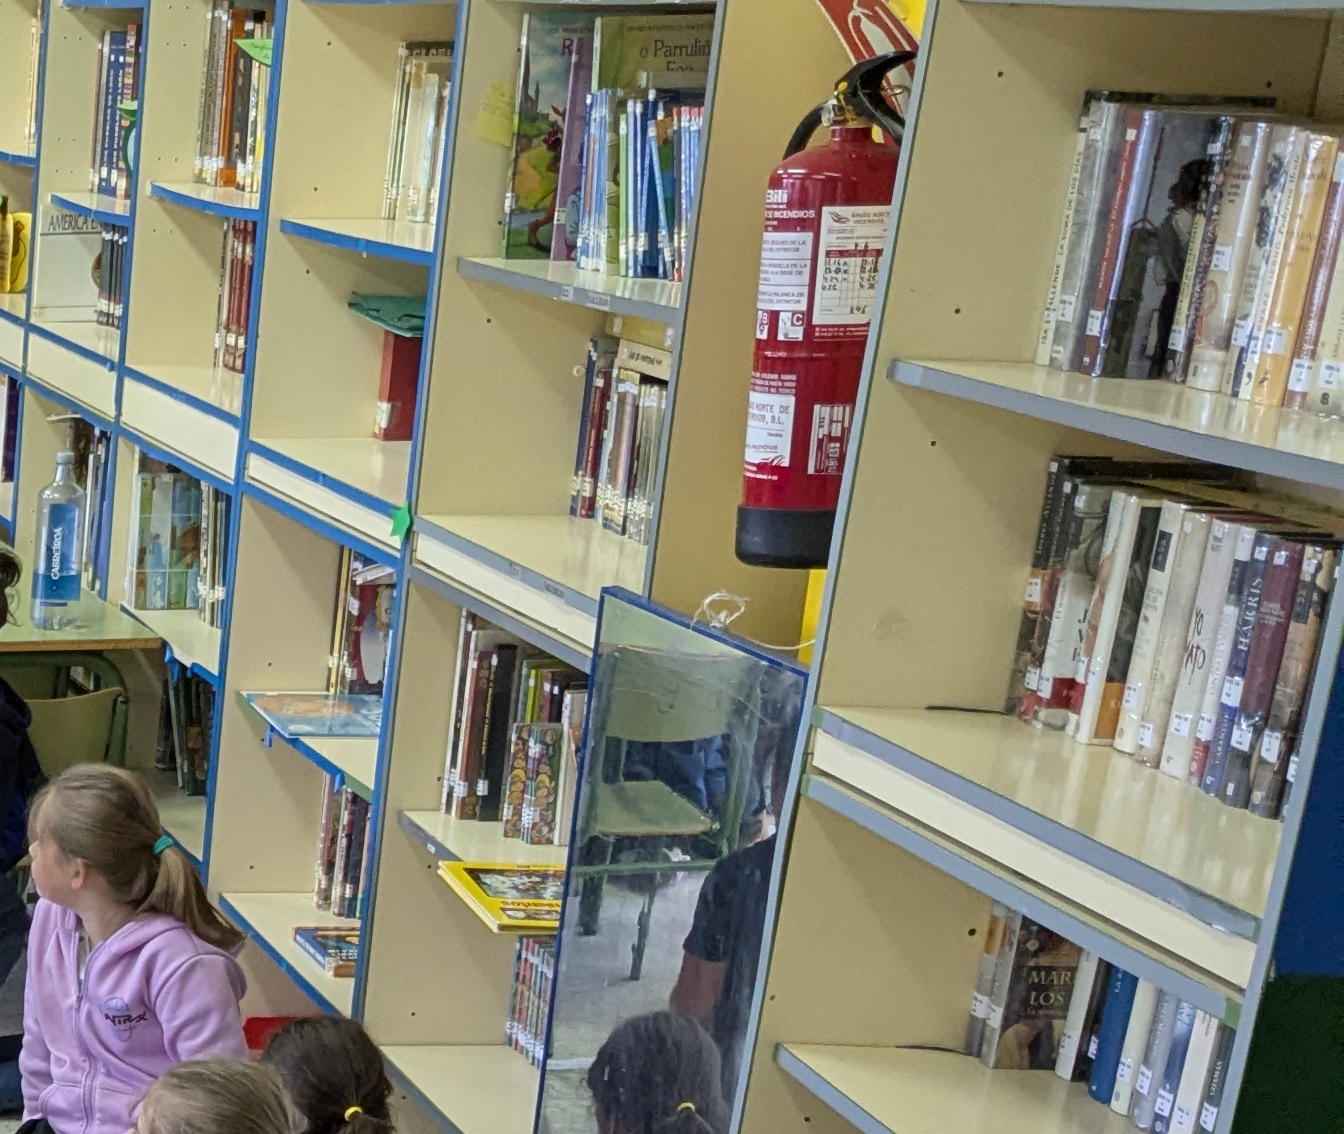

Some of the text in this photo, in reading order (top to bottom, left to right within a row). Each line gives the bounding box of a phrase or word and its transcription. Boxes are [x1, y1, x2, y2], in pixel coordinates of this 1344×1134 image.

[793, 314, 803, 325] C
[779, 406, 790, 414] DE
[1238, 577, 1263, 652] HARRIS
[1029, 970, 1074, 985] MAR
[1030, 992, 1064, 1006] LOS
